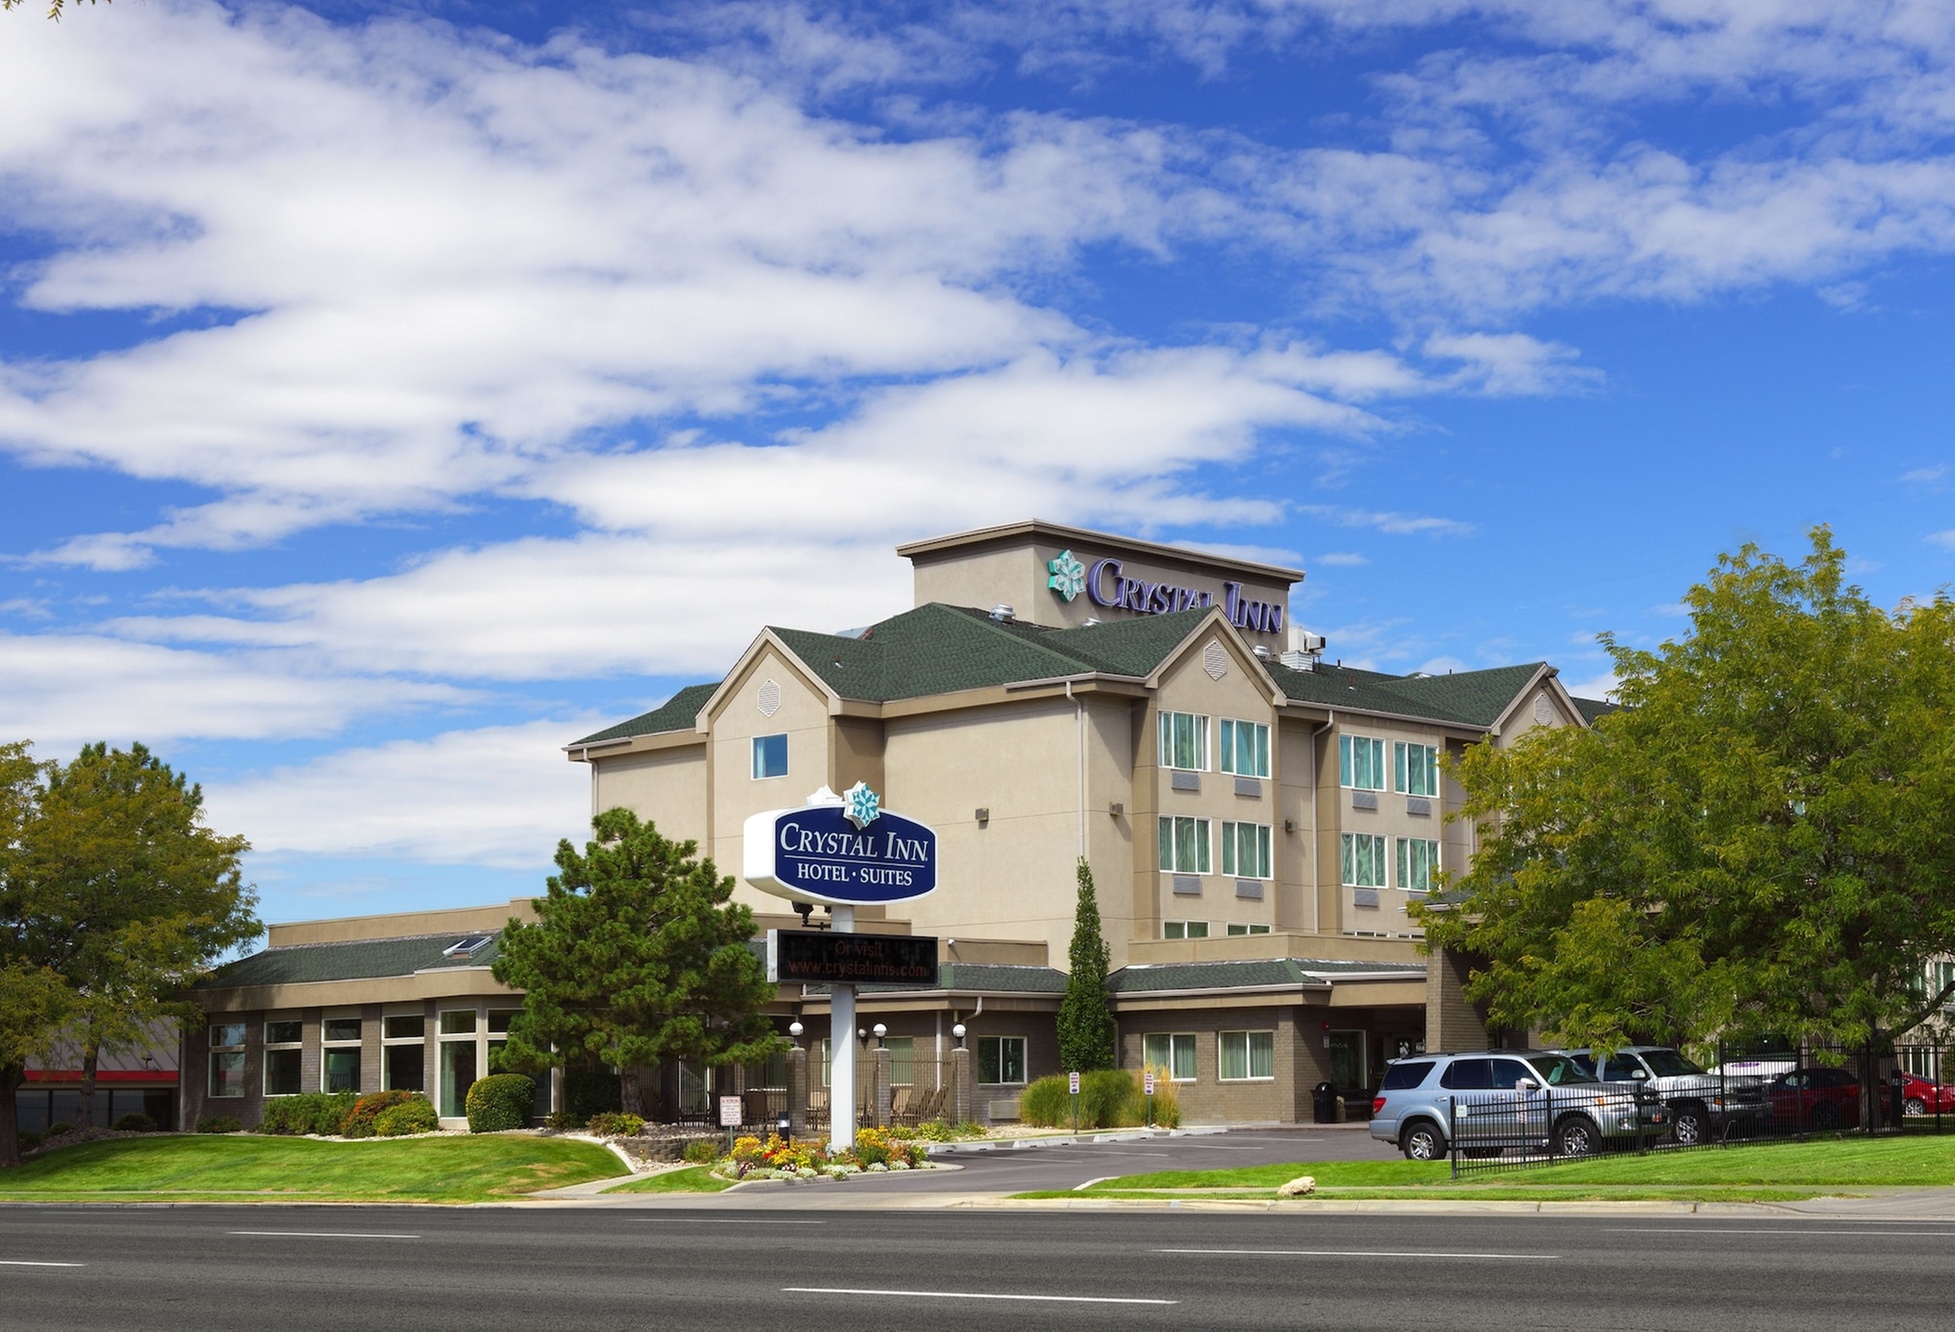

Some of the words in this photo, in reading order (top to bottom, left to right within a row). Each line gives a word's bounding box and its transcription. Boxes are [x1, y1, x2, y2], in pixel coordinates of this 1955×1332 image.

[1224, 581, 1284, 633] INN
[780, 823, 878, 857] CRYSTAL
[884, 832, 928, 861] INN
[797, 863, 849, 881] HOTEL
[860, 868, 912, 885] SUITES
[834, 940, 850, 956] Or
[857, 942, 882, 957] visit
[788, 959, 927, 978] www.crystalinns.com
